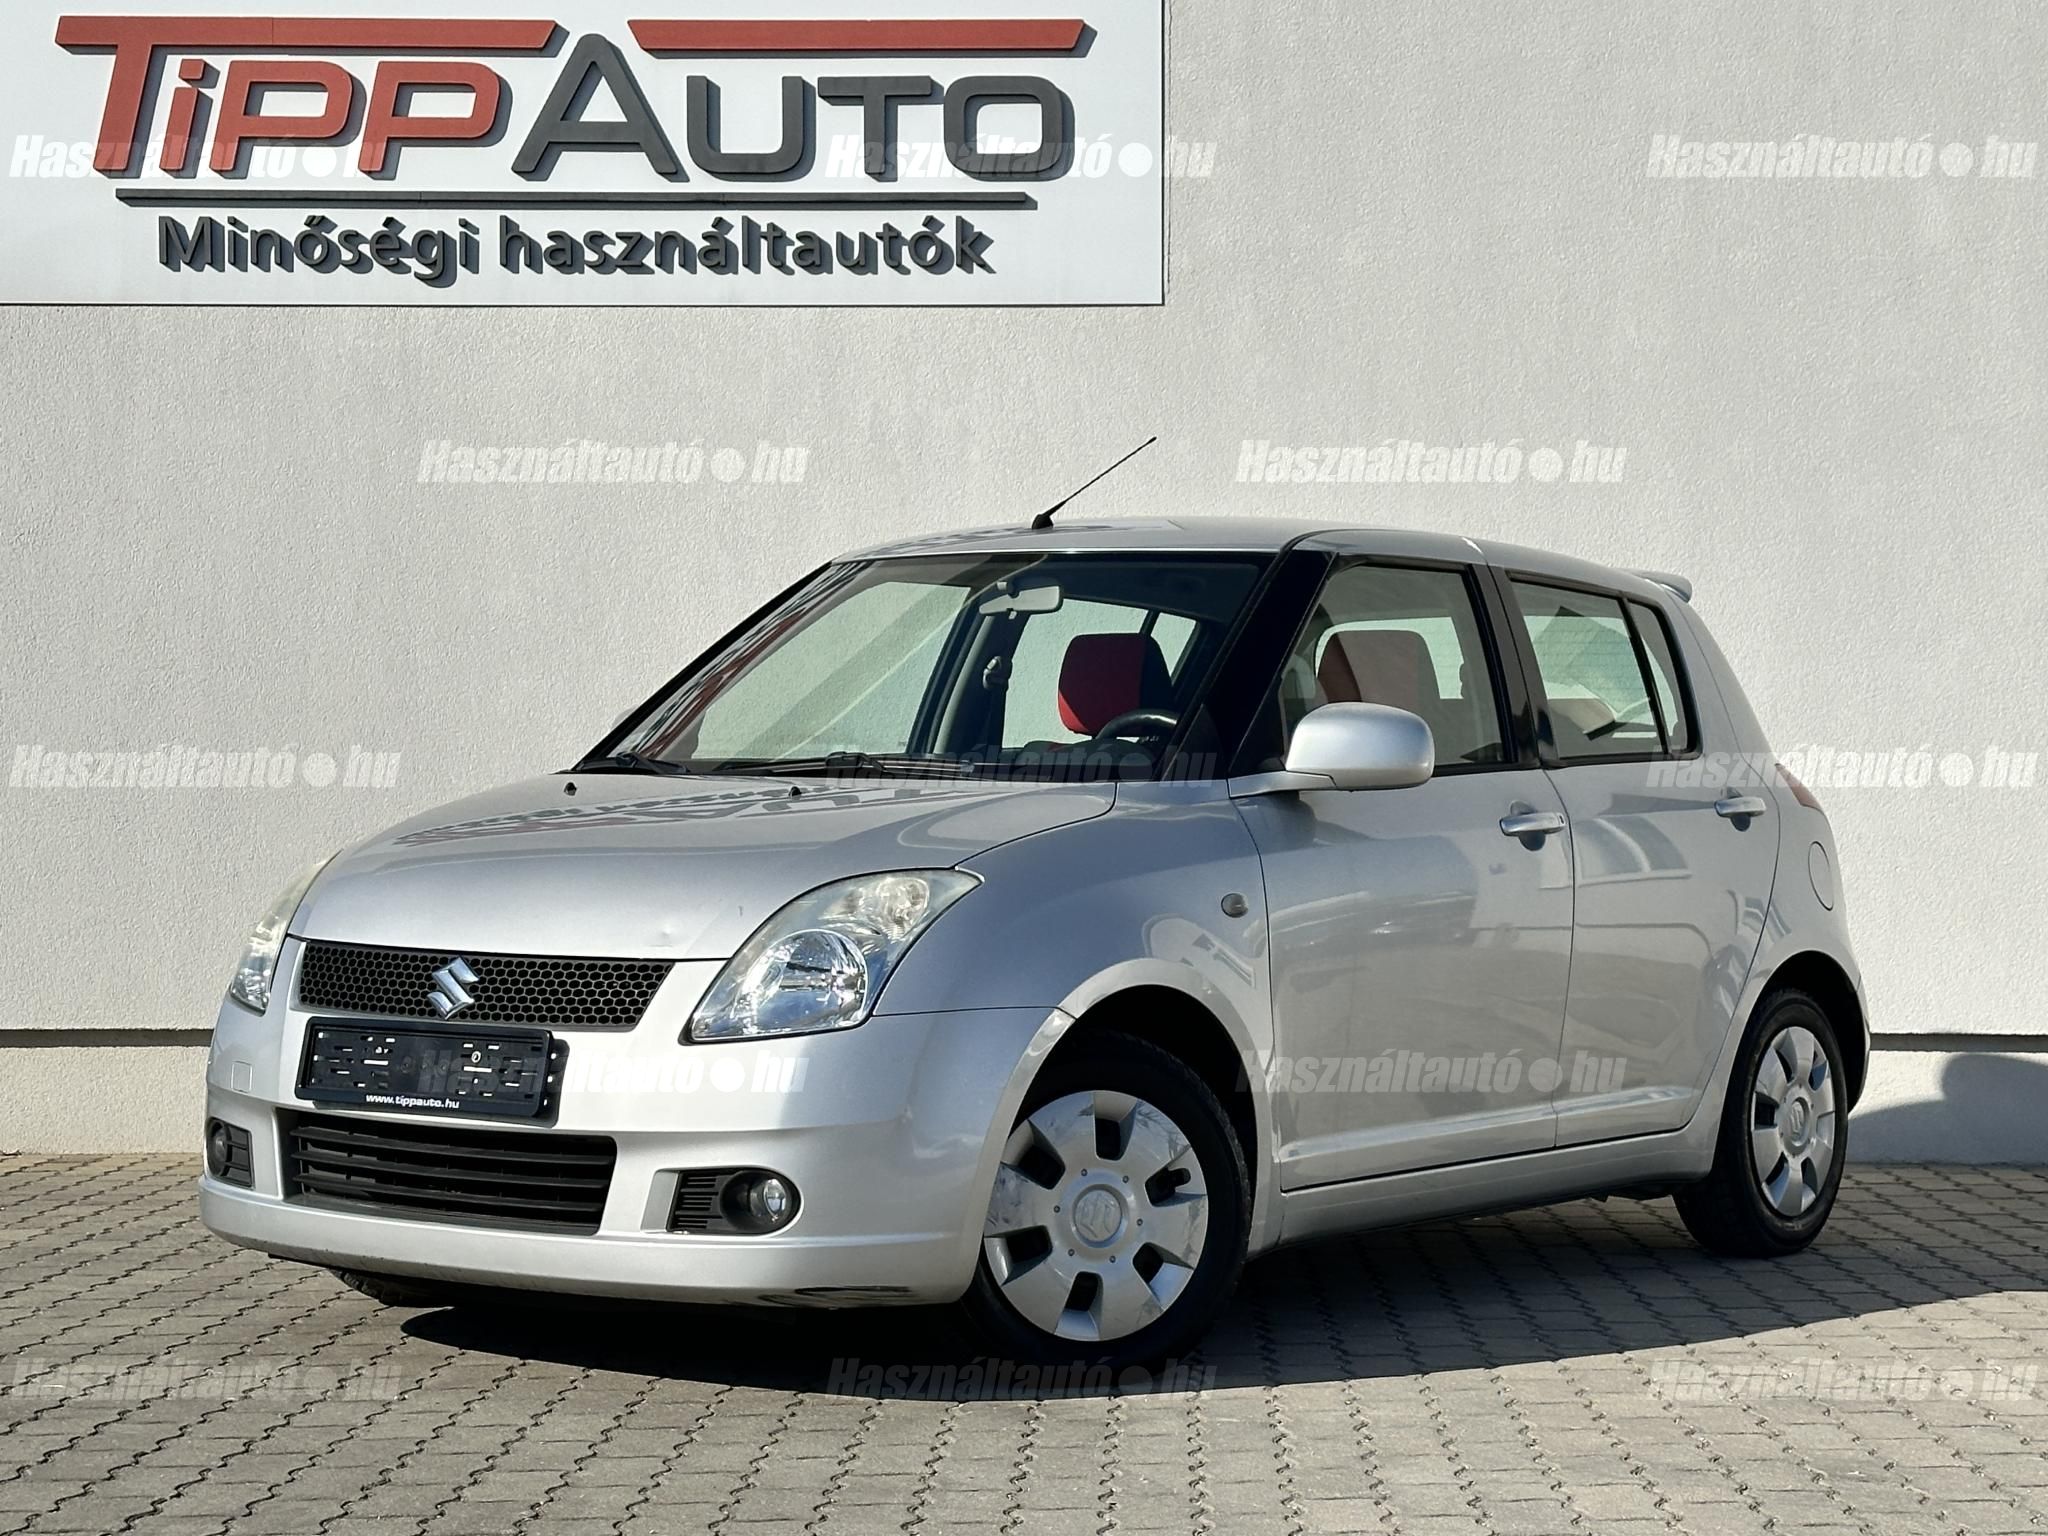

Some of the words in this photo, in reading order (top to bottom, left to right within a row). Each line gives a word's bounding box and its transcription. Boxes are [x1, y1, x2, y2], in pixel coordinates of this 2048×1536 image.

[158, 215, 480, 288] Minőségi
[499, 215, 996, 275] használtautók
[365, 1094, 460, 1109] www.tippauto.hu
